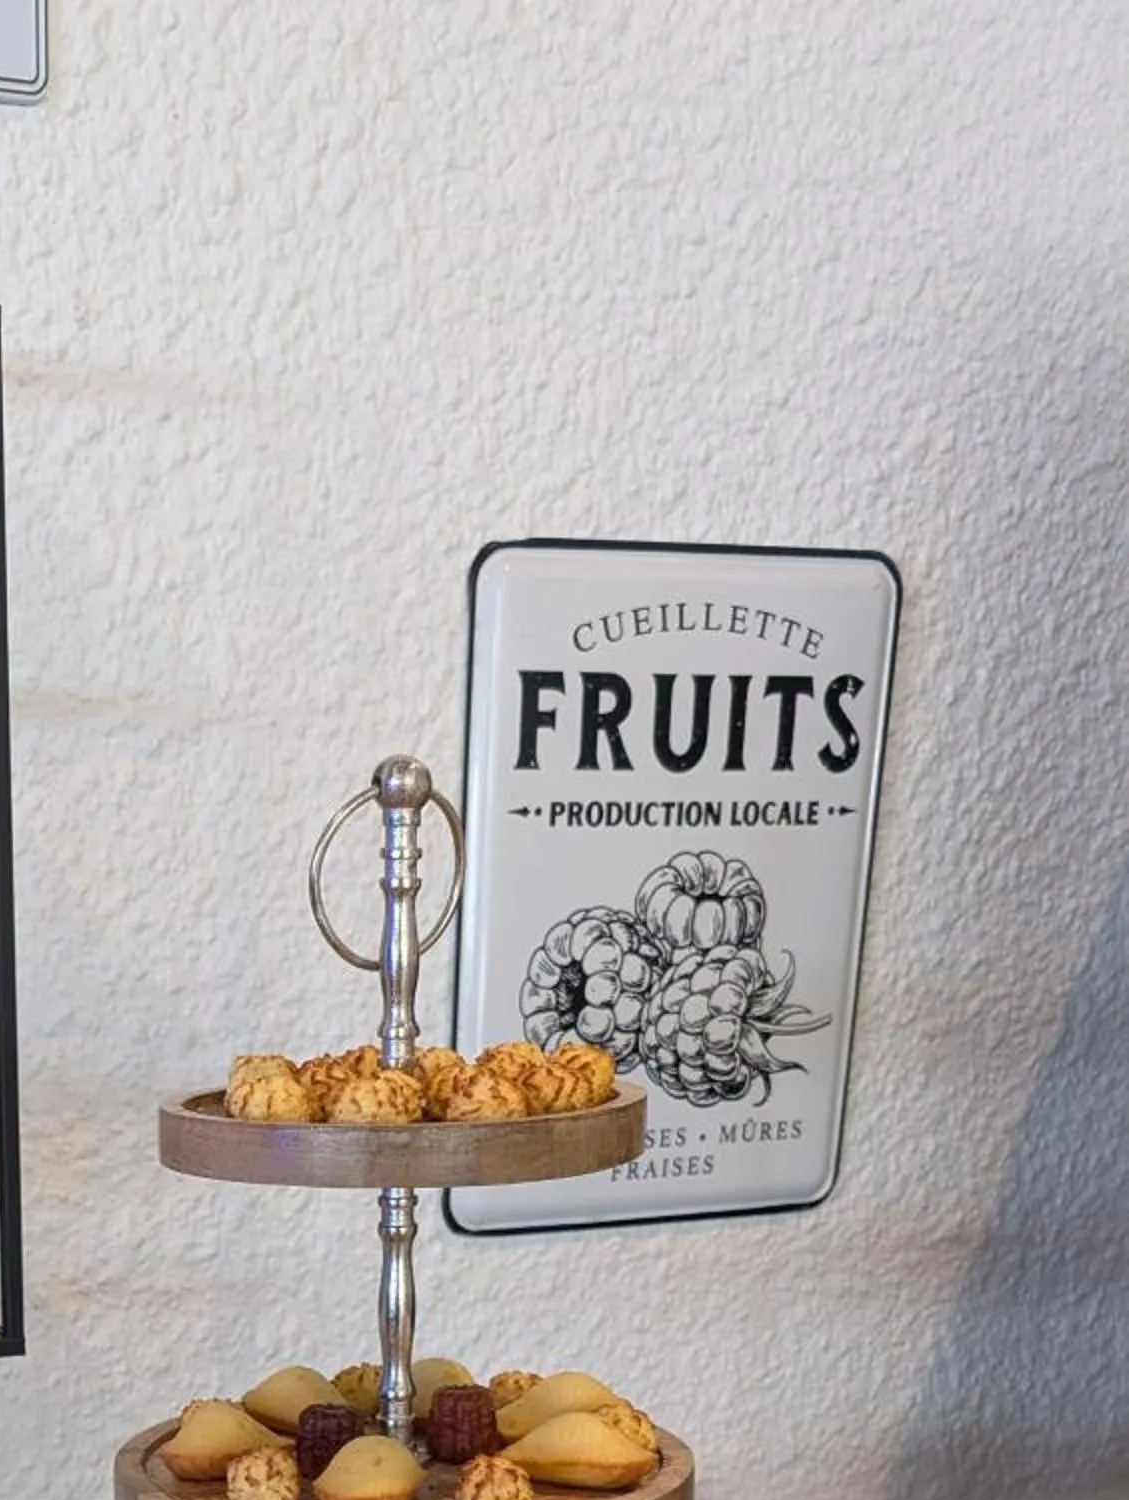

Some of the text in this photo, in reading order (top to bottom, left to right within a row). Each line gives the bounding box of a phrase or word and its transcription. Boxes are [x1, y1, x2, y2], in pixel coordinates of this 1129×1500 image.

[571, 602, 824, 660] CUEILLETTE
[513, 670, 865, 774] FRUITS
[549, 801, 819, 827] PRODUCTION LOCALE
[719, 1118, 803, 1144] MÛRES
[611, 1155, 715, 1182] FRAISES
